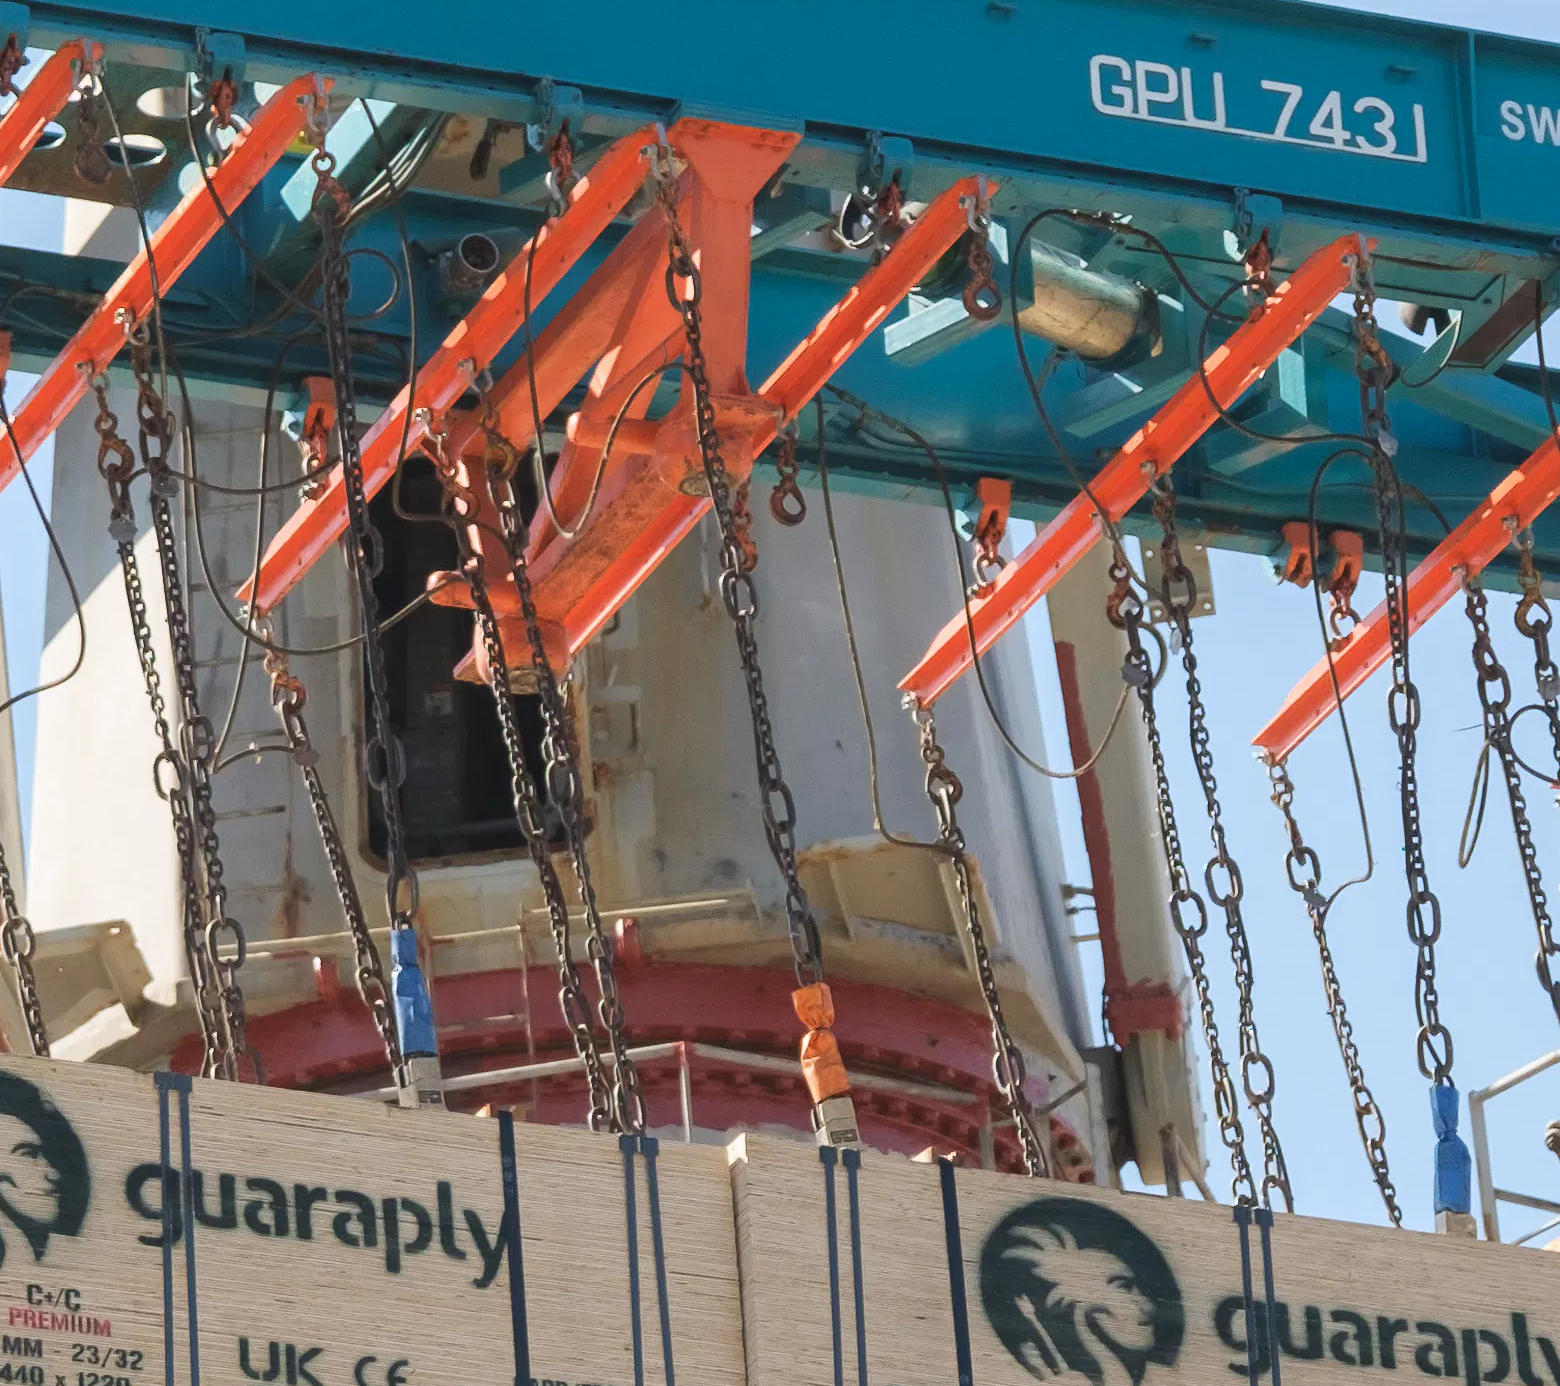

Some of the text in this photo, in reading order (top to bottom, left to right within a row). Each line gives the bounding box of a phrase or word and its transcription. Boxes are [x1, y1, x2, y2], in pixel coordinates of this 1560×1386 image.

[1088, 54, 1427, 163] GPU 7431
[124, 1162, 509, 1288] guaraply
[3, 1336, 43, 1357] MM
[71, 1343, 144, 1370] 23/32
[8, 1306, 112, 1337] PREMIUM
